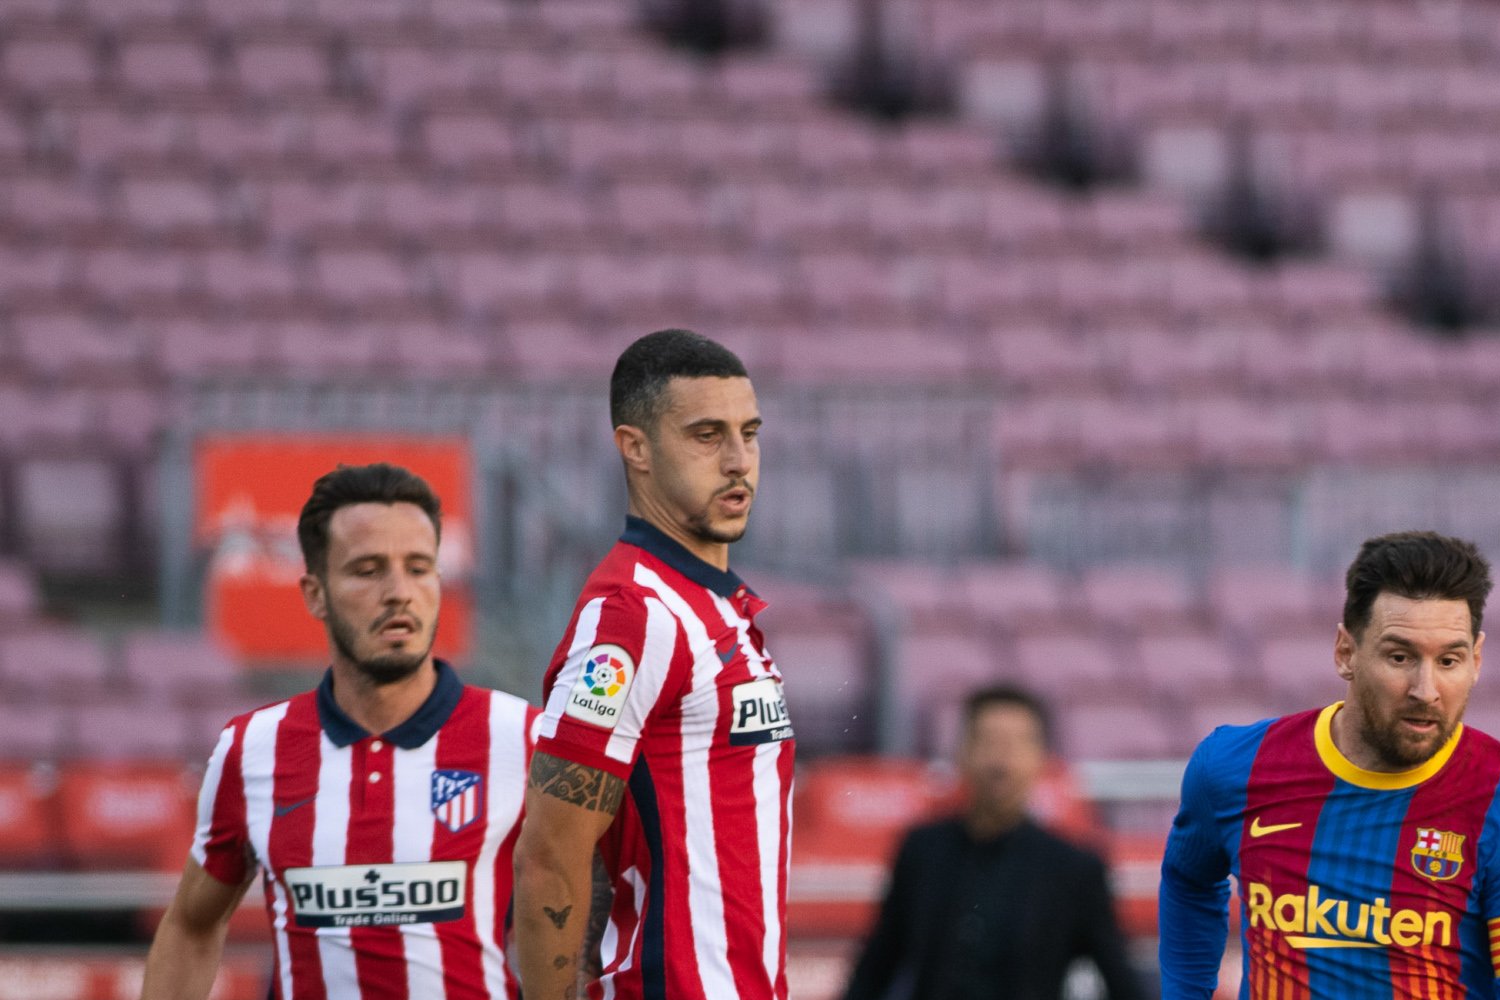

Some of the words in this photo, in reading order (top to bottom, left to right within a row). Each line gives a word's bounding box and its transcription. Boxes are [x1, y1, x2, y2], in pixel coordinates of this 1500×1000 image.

[573, 694, 617, 717] LaLiga
[292, 879, 459, 909] Plus500
[333, 914, 372, 926] Trade
[1249, 882, 1452, 948] Rakuten
